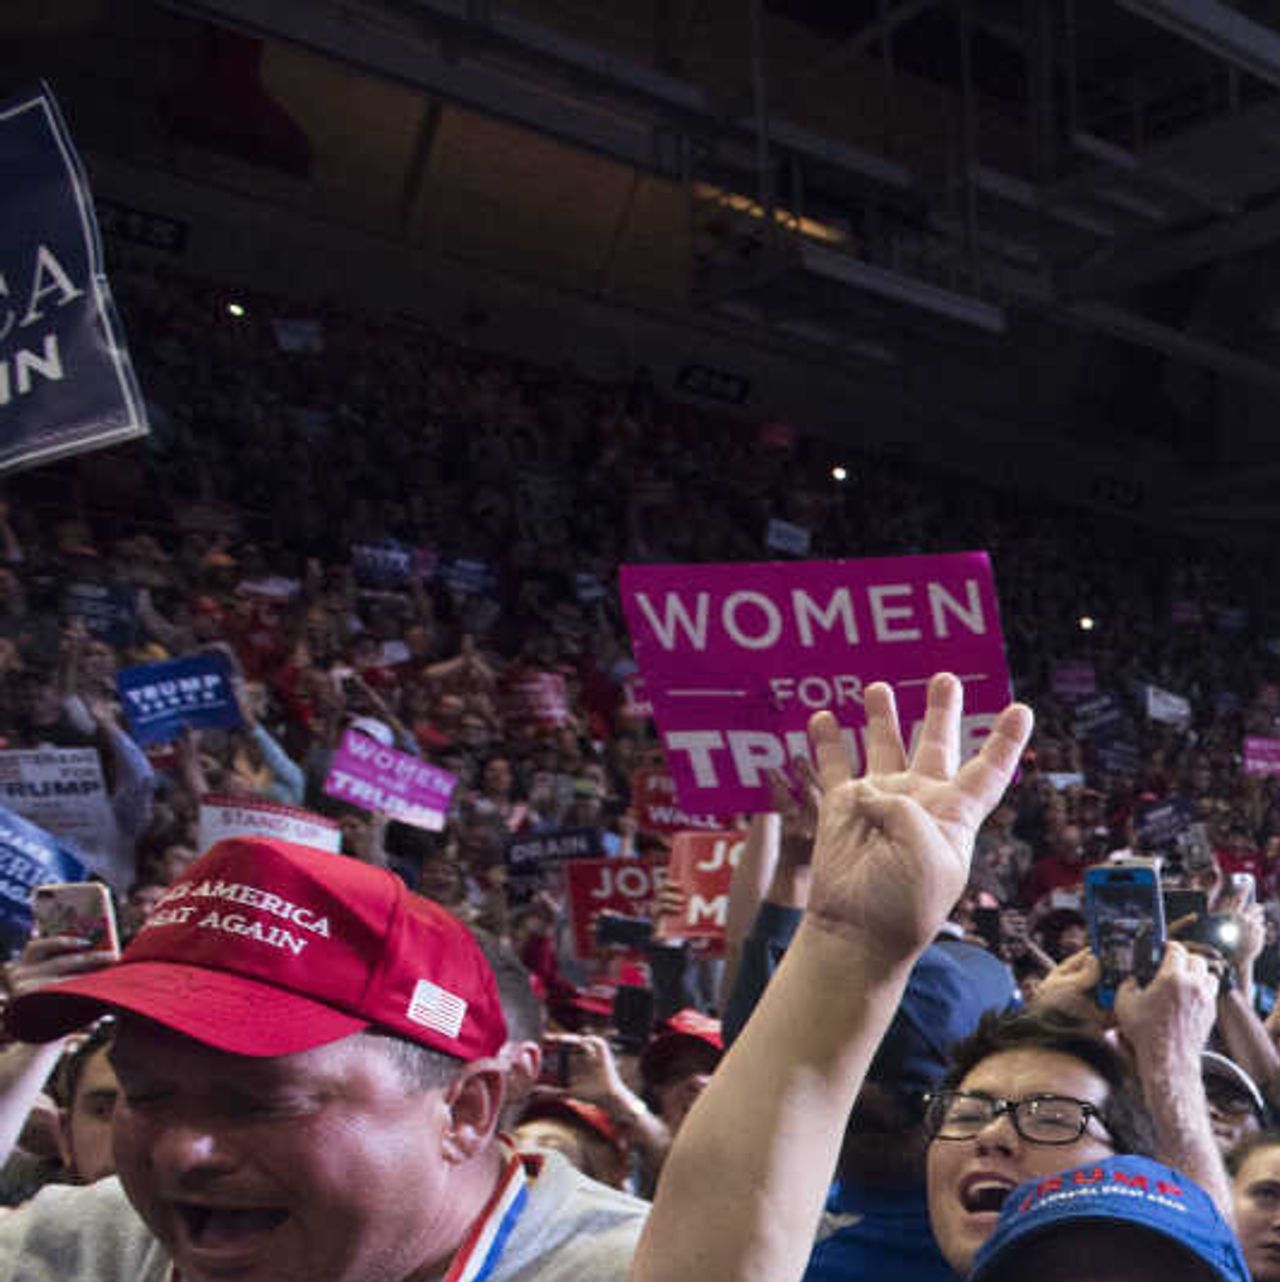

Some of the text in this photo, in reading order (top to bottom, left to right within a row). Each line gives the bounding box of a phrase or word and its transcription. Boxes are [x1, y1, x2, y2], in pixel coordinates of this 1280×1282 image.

[636, 579, 988, 651] WOMEN
[770, 675, 866, 709] FOR
[192, 880, 331, 938] AMERICA
[198, 911, 309, 955] AGAIN
